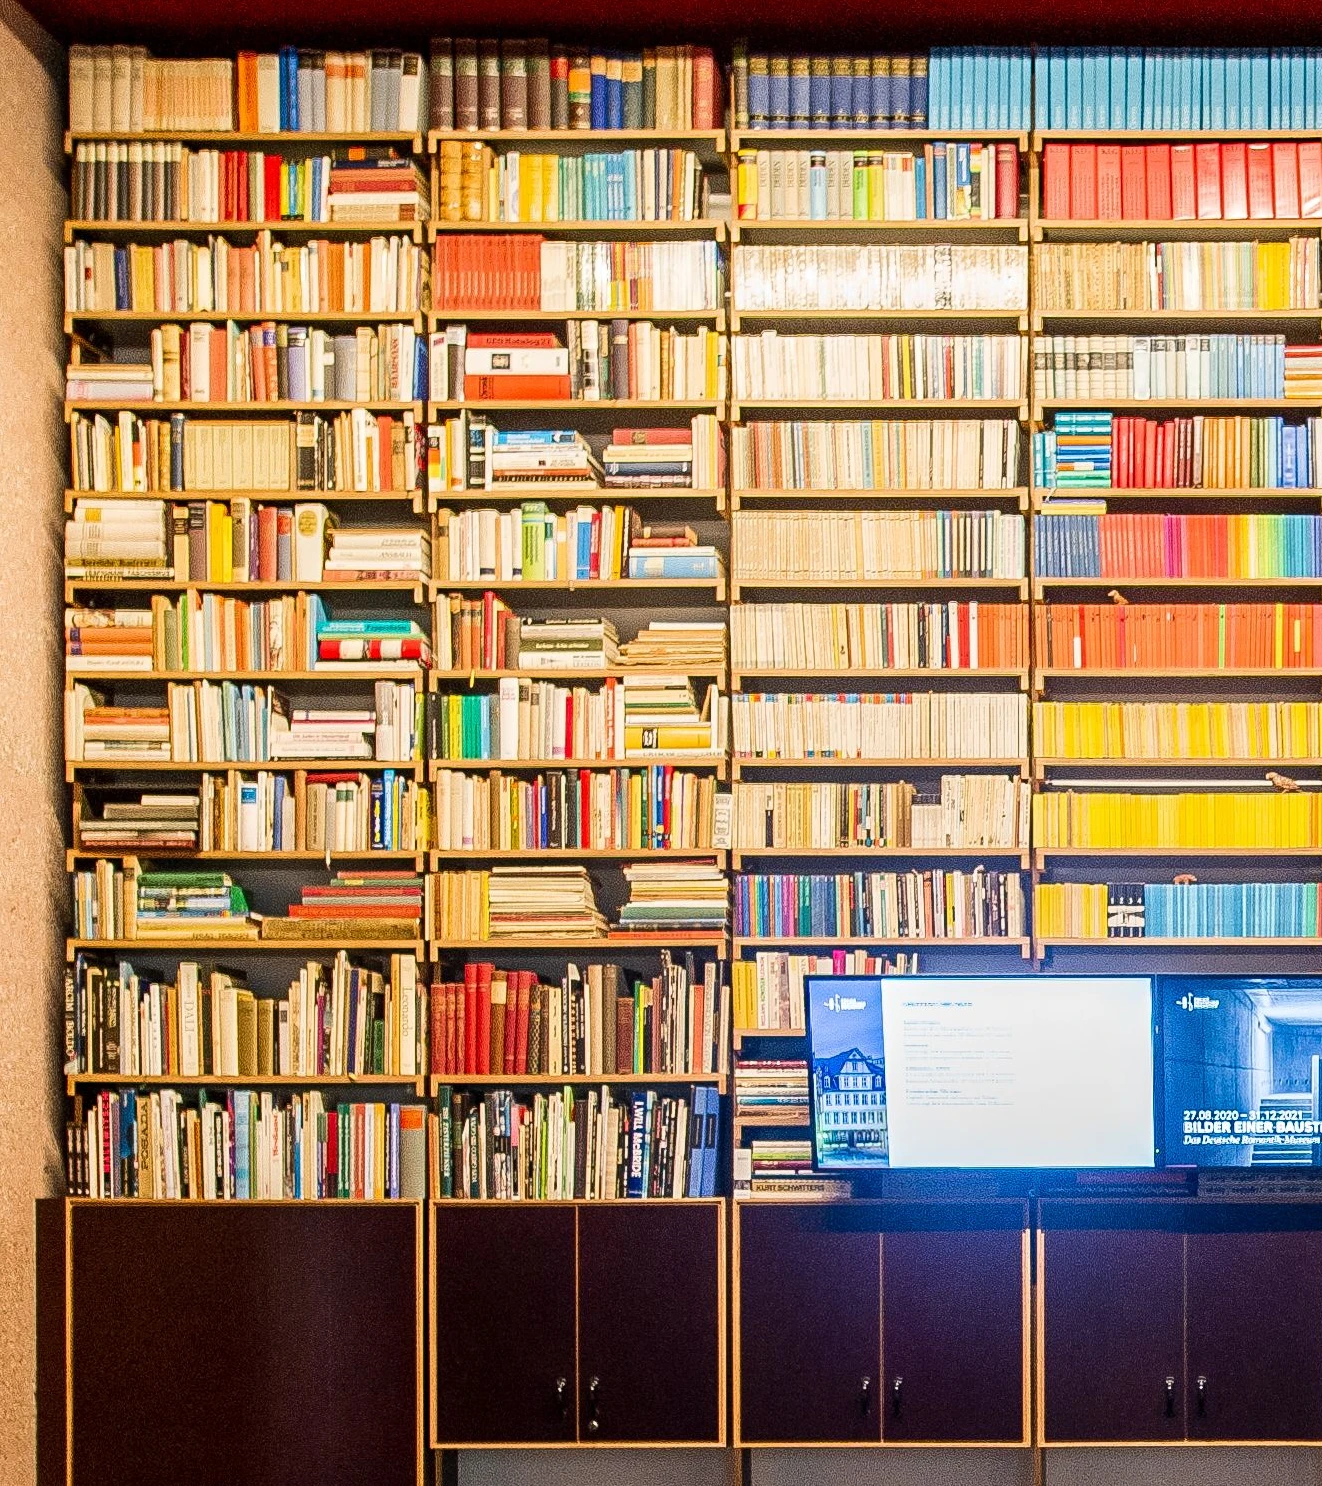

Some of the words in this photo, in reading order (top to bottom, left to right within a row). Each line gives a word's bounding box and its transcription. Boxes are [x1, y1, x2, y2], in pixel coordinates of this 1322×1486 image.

[184, 1001, 195, 1033] DALI
[402, 986, 413, 1037] Leonardo
[1183, 1110, 1239, 1121] 27.08.2020
[1249, 1110, 1303, 1121] 31.12.2021
[141, 1101, 149, 1171] POSADA
[1183, 1121, 1232, 1134] BILDER
[1234, 1121, 1275, 1134] EINER
[1183, 1135, 1201, 1145] Das
[1202, 1135, 1240, 1145] Deutsche
[632, 1132, 644, 1178] McBRIDE
[756, 1184, 777, 1192] KURT
[777, 1184, 825, 1192] SCHWITTERS
